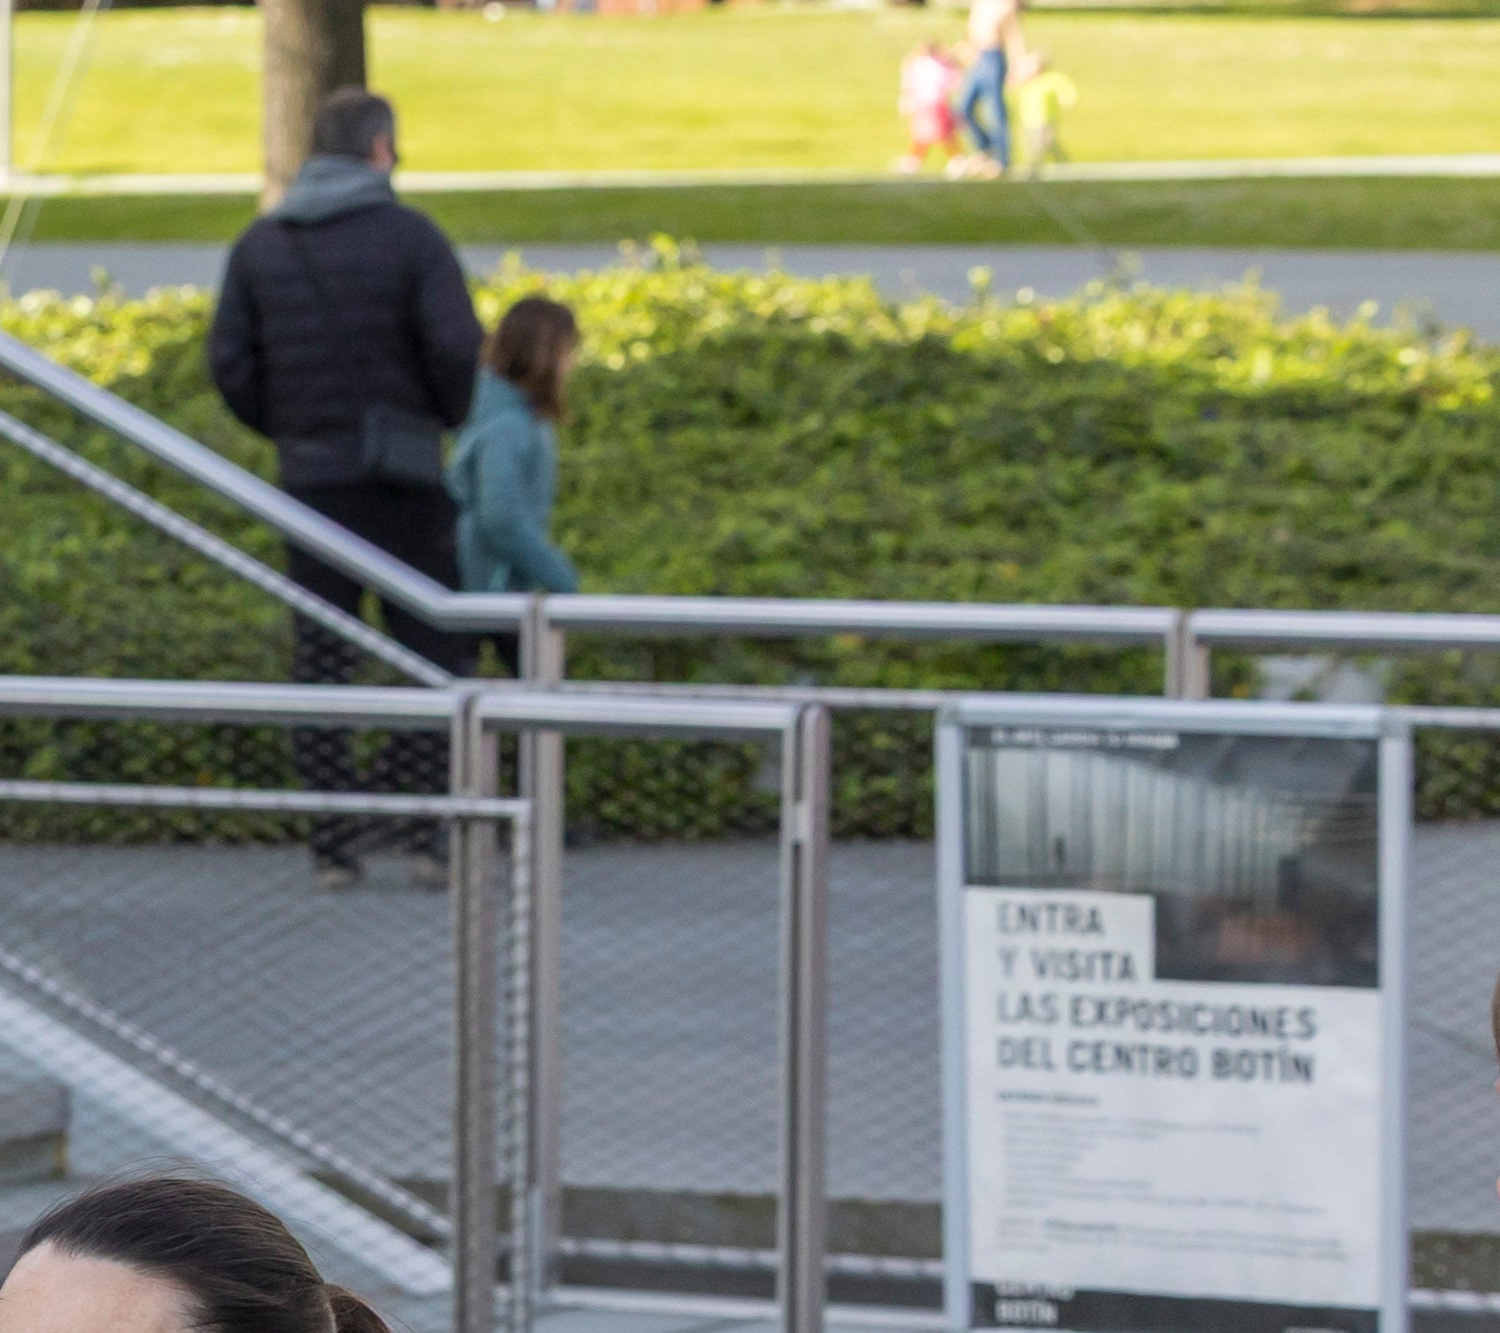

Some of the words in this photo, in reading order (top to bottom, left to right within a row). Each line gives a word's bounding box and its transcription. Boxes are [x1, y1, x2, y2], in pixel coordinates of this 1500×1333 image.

[996, 900, 1105, 935] ENTRA
[997, 949, 1016, 977] Y
[1030, 950, 1137, 982] VISITA
[998, 992, 1060, 1024] LAS
[1070, 995, 1317, 1040] EXPOSICIONES
[998, 1036, 1054, 1072] DEL
[1067, 1040, 1199, 1078] CENTRO
[1211, 1042, 1315, 1084] BOTÍN
